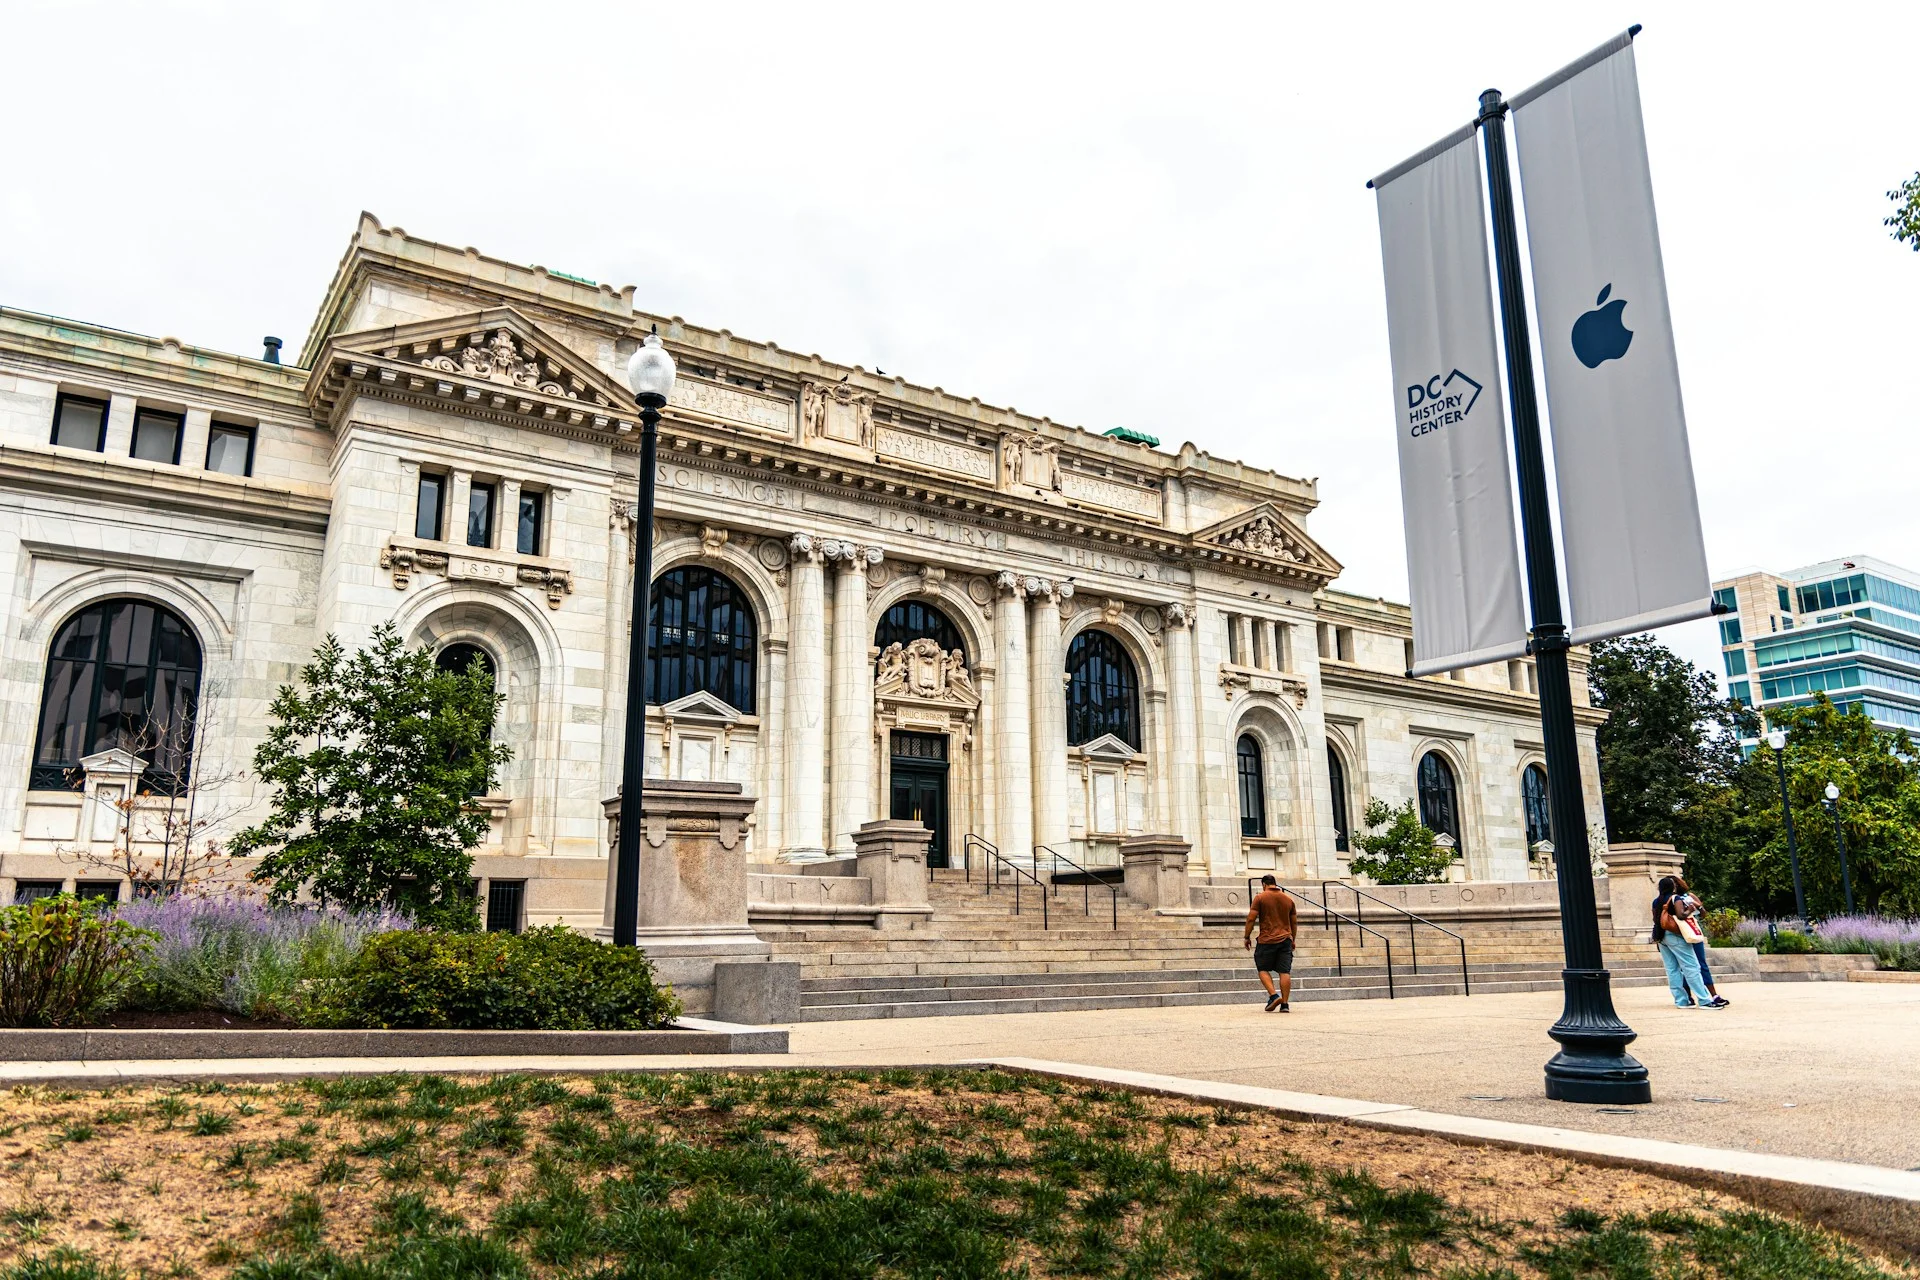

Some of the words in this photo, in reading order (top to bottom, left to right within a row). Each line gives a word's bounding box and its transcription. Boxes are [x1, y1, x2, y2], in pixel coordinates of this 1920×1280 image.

[1407, 374, 1442, 409] DC
[1409, 393, 1463, 424] HISTORY
[1411, 411, 1464, 437] CENTER
[879, 440, 926, 459] PVBLIC
[933, 453, 988, 475] LIBRARY
[884, 430, 982, 463] WASHINGTON
[656, 465, 786, 506] SCIENCE
[889, 511, 991, 547] POETRY
[461, 561, 505, 578] 1899
[1075, 549, 1162, 580] HISTORY
[1398, 886, 1541, 905] PEOPL
